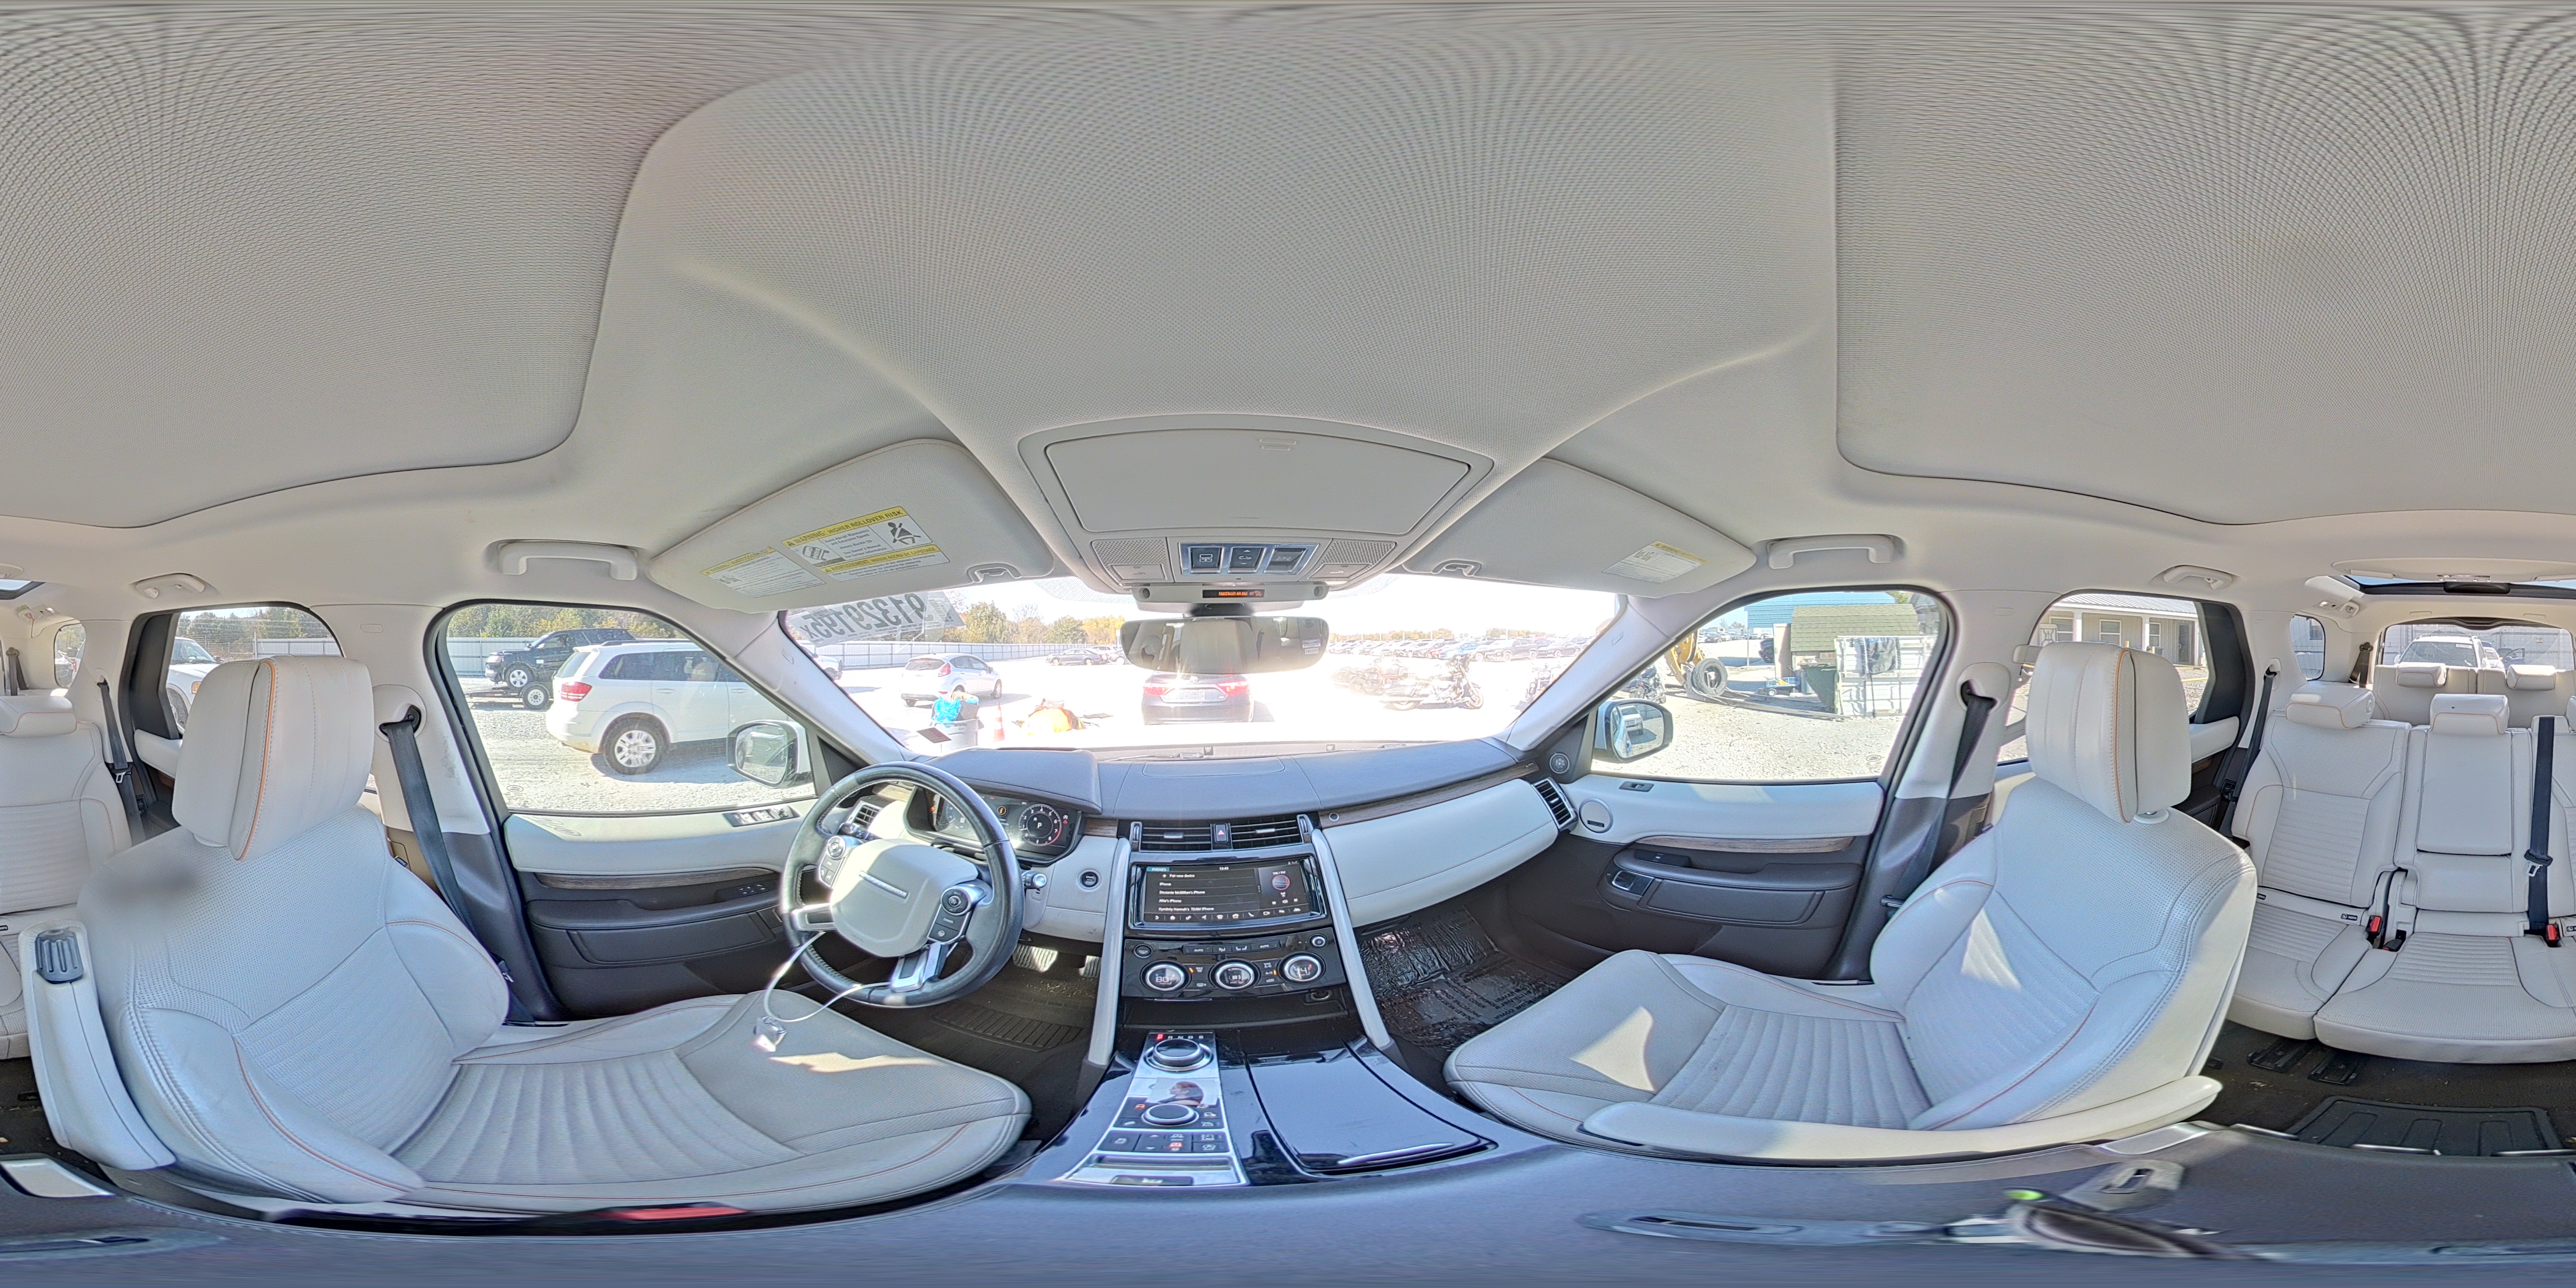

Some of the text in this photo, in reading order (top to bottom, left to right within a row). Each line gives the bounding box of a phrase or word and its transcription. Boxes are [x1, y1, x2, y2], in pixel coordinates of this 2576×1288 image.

[794, 531, 827, 544] WARNING:
[827, 525, 850, 534] HIGHER
[850, 515, 885, 527] ROLLOVER
[1469, 998, 1486, 1009] COVER
